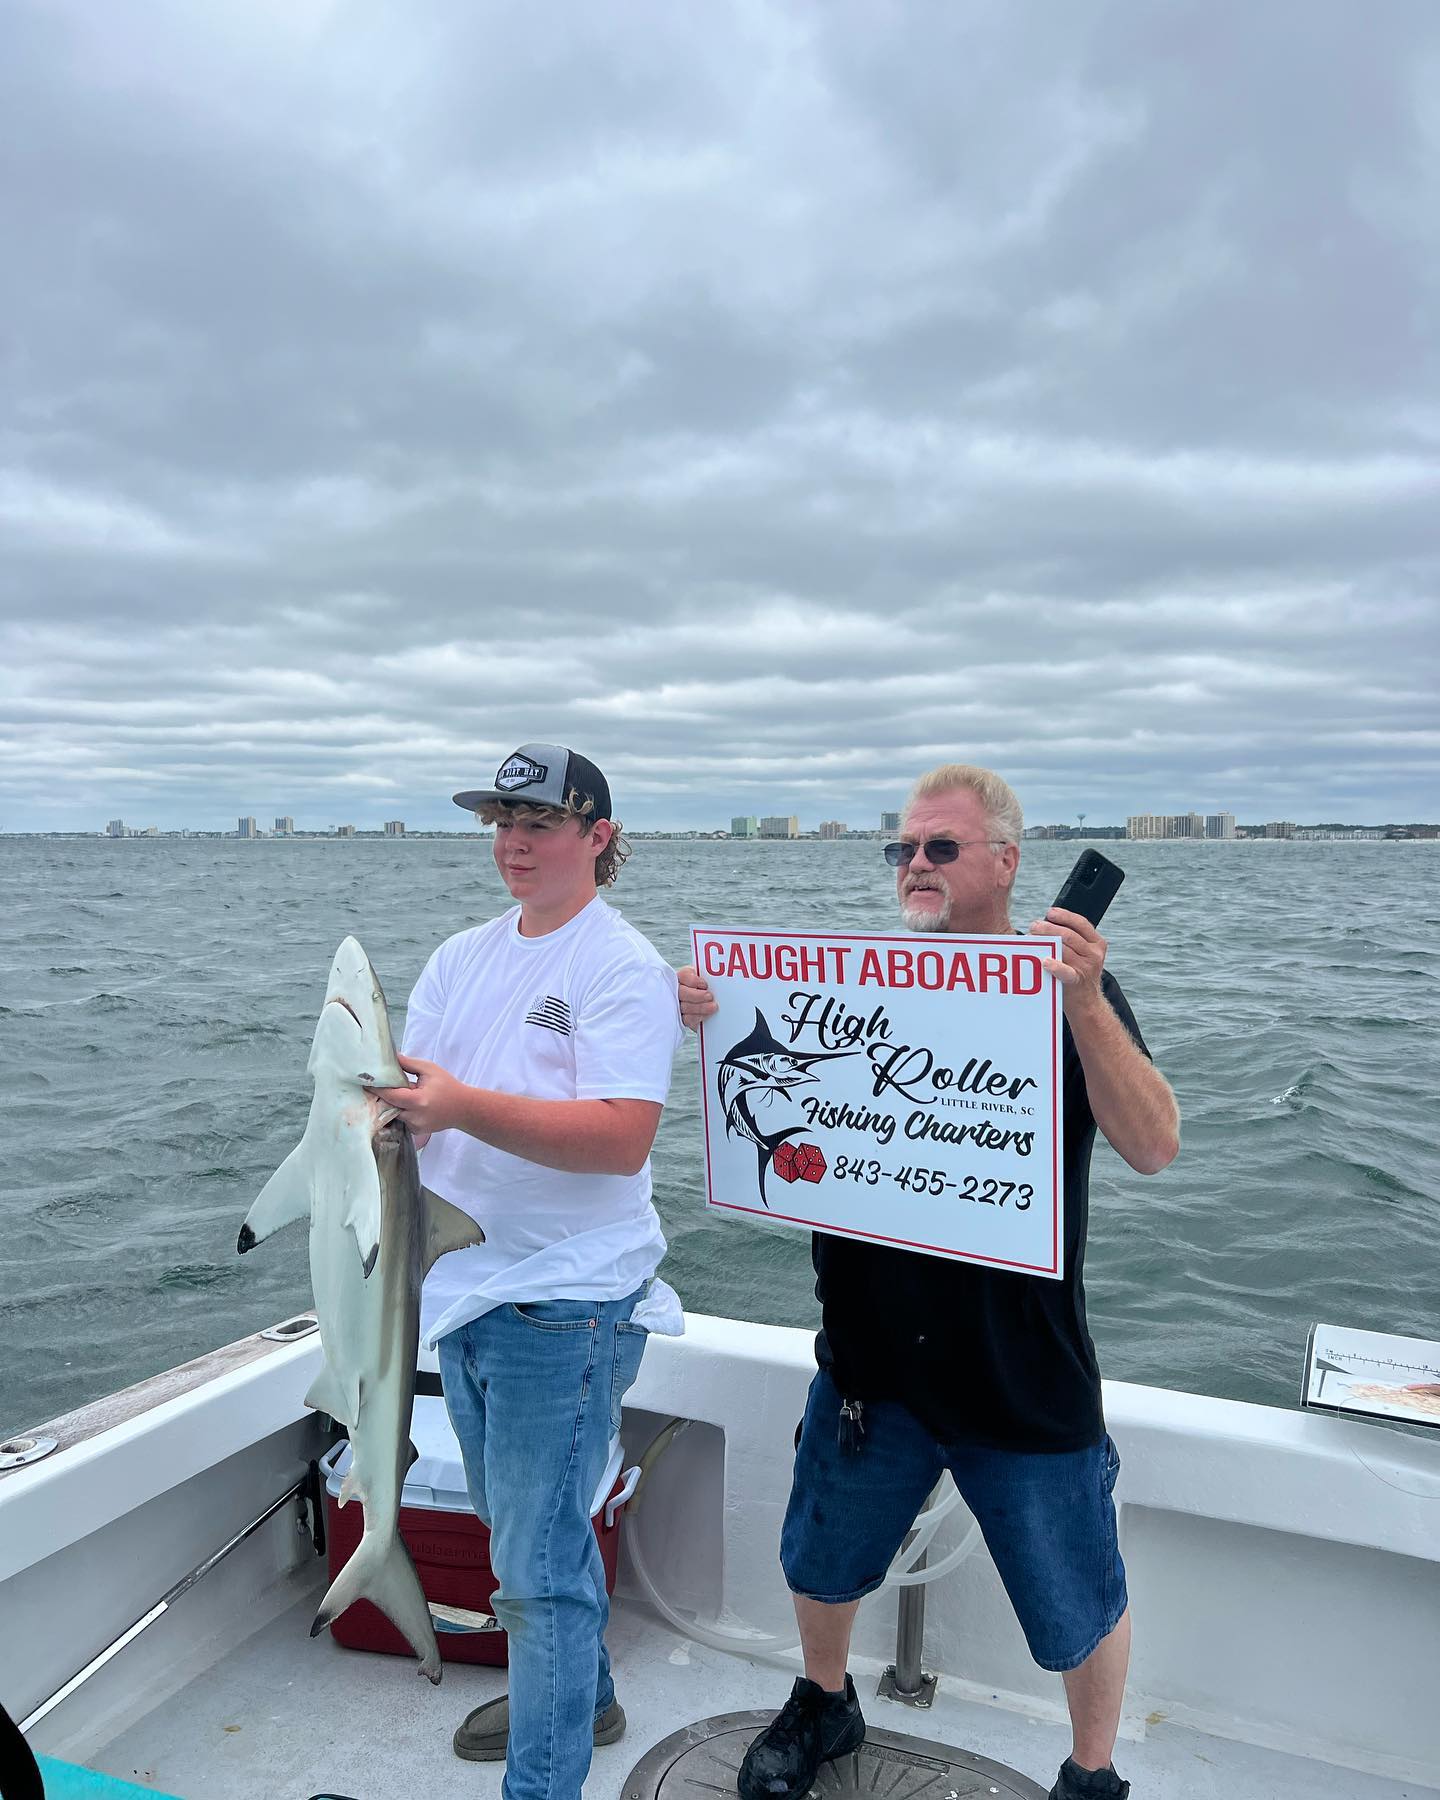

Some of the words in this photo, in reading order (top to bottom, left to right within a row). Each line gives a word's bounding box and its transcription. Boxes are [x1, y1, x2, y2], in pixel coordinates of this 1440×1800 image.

[523, 768, 540, 776] HAT
[705, 941, 851, 984] CAUGHT
[858, 949, 1042, 995] ABOARD
[781, 992, 893, 1050] High
[867, 1042, 1038, 1104] Roller
[800, 1096, 896, 1145] Fishing
[904, 1111, 1035, 1156] Charters
[941, 1097, 978, 1110] LITTLE
[981, 1102, 1017, 1115] RIVER,
[1020, 1106, 1035, 1116] SC
[833, 1155, 1034, 1210] 843-455-2273
